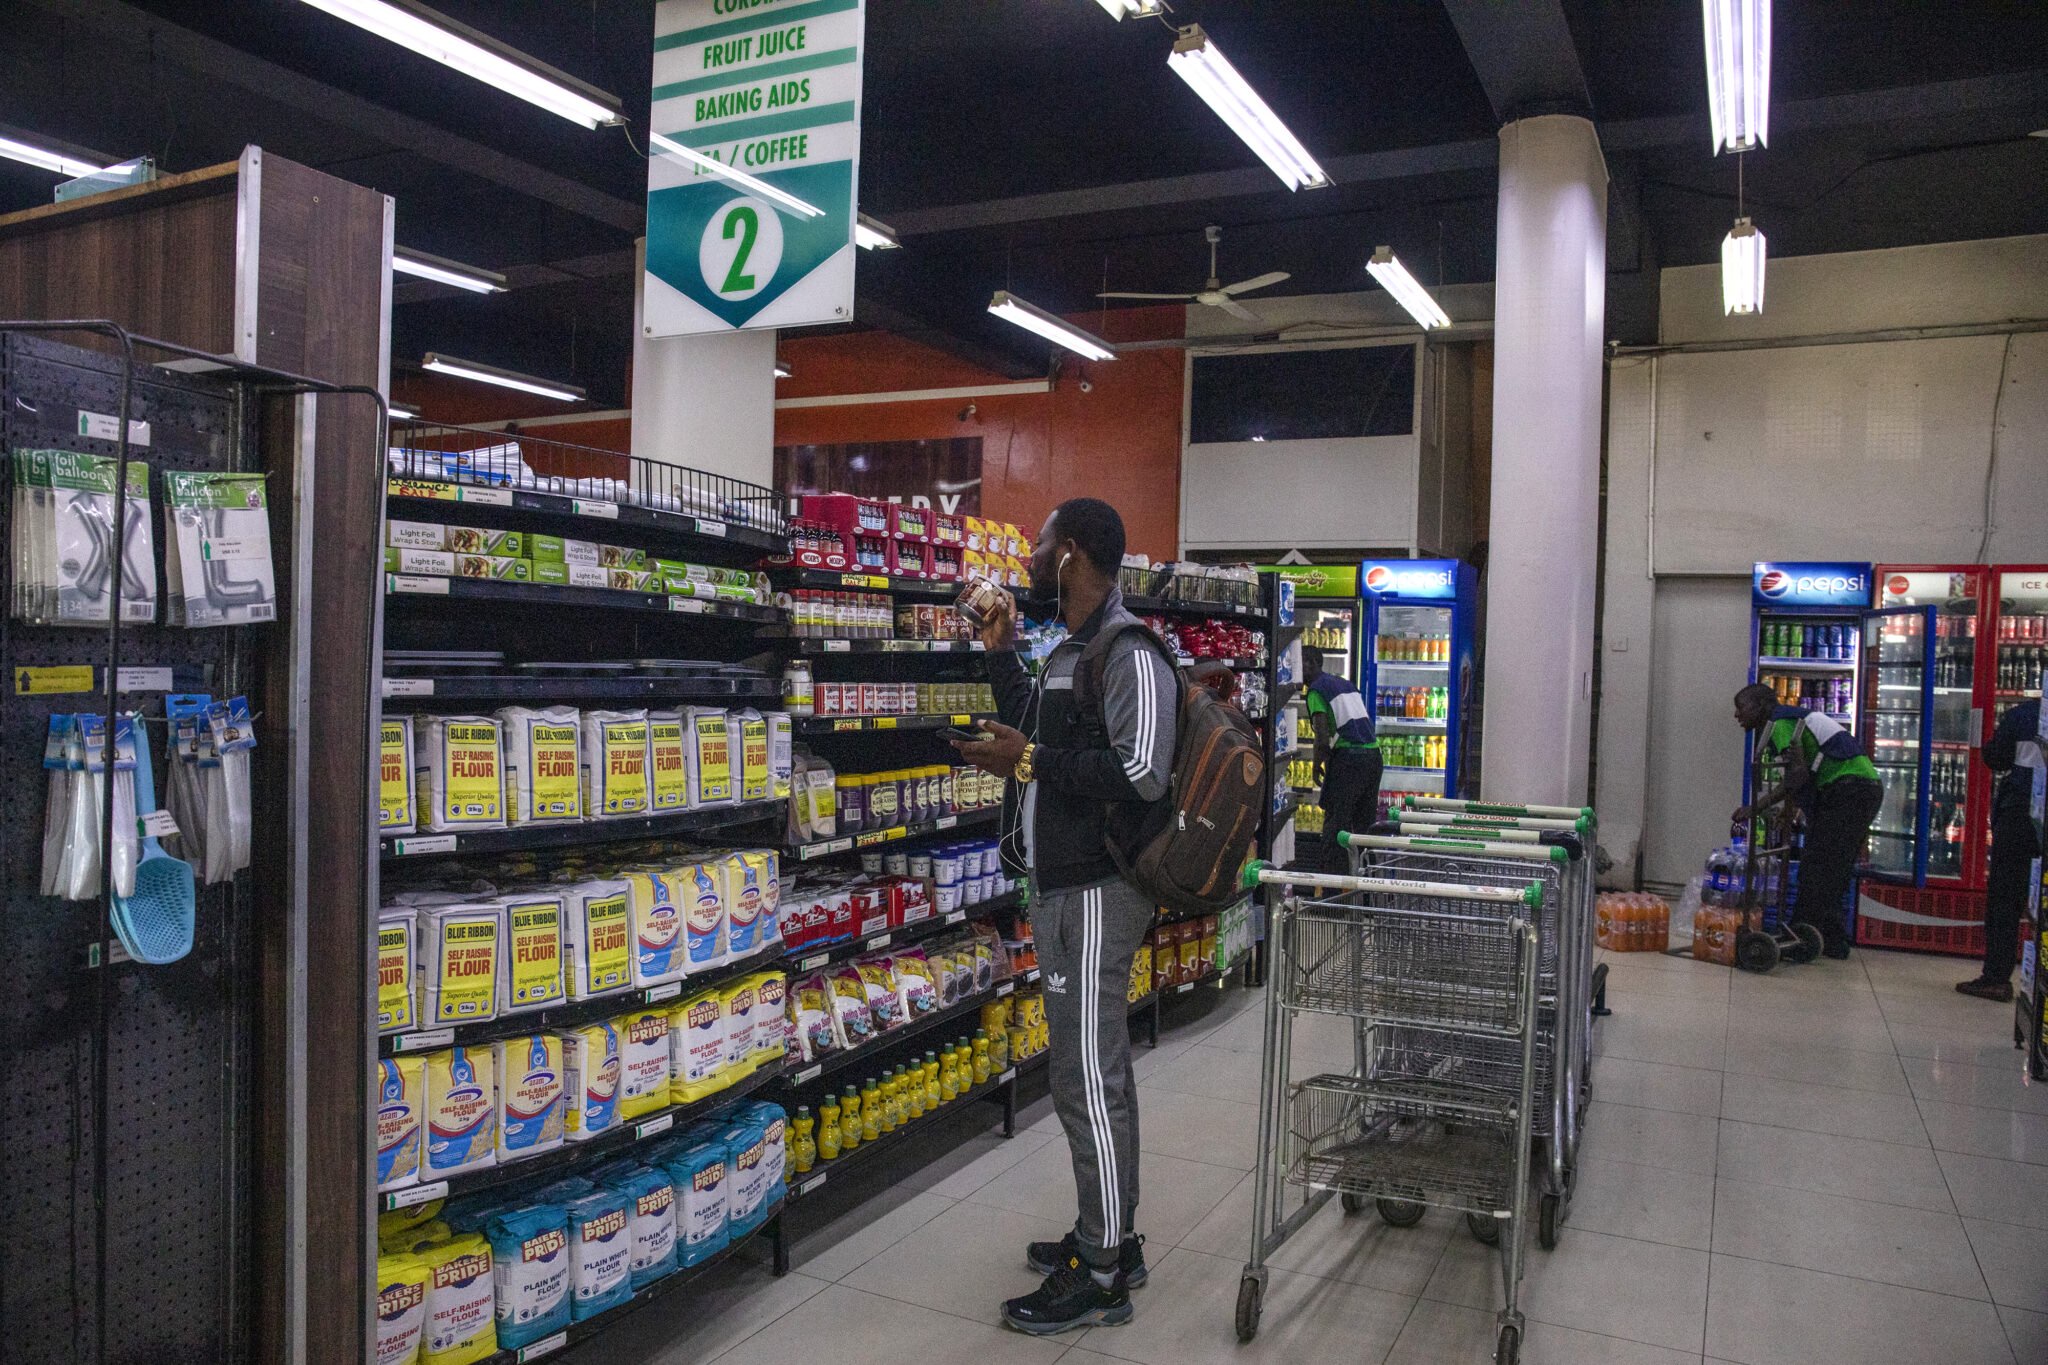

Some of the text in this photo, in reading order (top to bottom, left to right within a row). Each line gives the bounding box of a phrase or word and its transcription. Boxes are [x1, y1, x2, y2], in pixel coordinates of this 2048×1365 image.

[703, 26, 806, 69] FRUIT JUICE
[695, 78, 810, 122] BAKING AIDS
[745, 135, 807, 167] COFFEE
[720, 206, 759, 293] 2
[55, 454, 76, 466] foil
[57, 467, 106, 480] balloon
[177, 486, 221, 496] balloon
[400, 487, 437, 497] SALE
[400, 529, 419, 538] Light
[394, 536, 412, 545] Wrap
[570, 546, 582, 554] Light
[410, 557, 430, 566] Light
[405, 565, 423, 574] Wrap
[1397, 569, 1452, 588] pepsi
[1796, 573, 1865, 594] pepsi
[2022, 581, 2041, 589] ICE
[451, 728, 494, 741] BLUE RIBBON
[536, 730, 574, 740] BLUE RIBBON
[609, 730, 625, 740] BLUE
[654, 728, 667, 738] BLUE
[698, 724, 712, 734] BLUE
[745, 728, 755, 736] BLUE
[656, 747, 680, 756] SELF RAISING
[702, 742, 713, 750] SELF
[747, 745, 756, 753] SELF
[452, 751, 494, 761] SELF RAISING
[538, 751, 574, 760] SELF RAISING
[611, 751, 625, 759] SELF
[703, 752, 727, 765] FLOUR
[747, 754, 766, 766] FLOUR
[452, 762, 494, 777] FLOUR
[538, 762, 574, 776] FLOUR
[657, 757, 681, 771] FLOUR
[477, 792, 495, 801] Quality
[468, 806, 482, 814] 2kg
[1390, 880, 1426, 888] World
[591, 902, 625, 918] BLUE RIBBON
[694, 905, 721, 916] SELF-RAISING
[515, 913, 556, 927] BLUE RIBBON
[647, 918, 678, 929] SELF-RAISING
[448, 926, 493, 939] BLUE RIBBON
[593, 923, 625, 937] SELF RAISING
[657, 924, 672, 932] FLOUR
[517, 934, 556, 946] SELF RAISING
[594, 933, 625, 952] FLOUR
[448, 948, 491, 960] SELF RAISING
[517, 945, 555, 963] FLOUR
[448, 959, 490, 977] FLOUR
[1048, 985, 1066, 993] adidas
[690, 1003, 718, 1016] BAKERS
[631, 1017, 666, 1031] BAKERS
[690, 1009, 719, 1027] PRIDE
[631, 1024, 668, 1041] PRIDE
[690, 1039, 723, 1055] SELF-RAISING
[701, 1049, 717, 1058] FLOUR
[628, 1055, 668, 1071] SELF-RAISING
[641, 1065, 660, 1075] FLOUR
[517, 1083, 558, 1097] SELF-RAISING
[529, 1091, 549, 1100] FLOUR
[455, 1094, 471, 1102] azam
[440, 1099, 487, 1115] SELF-RAISING
[453, 1108, 477, 1117] FLOUR
[380, 1112, 398, 1120] azam
[739, 1147, 764, 1170] PRIDE
[695, 1162, 724, 1179] BAKERS
[695, 1171, 724, 1191] PRIDE
[639, 1185, 672, 1204] BAKERS
[738, 1183, 753, 1194] PLAIN
[639, 1192, 673, 1215] PRIDE
[694, 1198, 725, 1217] PLAIN WHITE
[585, 1209, 624, 1229] BAKERS
[704, 1210, 719, 1220] FLOUR
[585, 1219, 625, 1241] PRIDE
[639, 1232, 660, 1243] PLAIN
[651, 1233, 668, 1246] FLOUR
[524, 1235, 565, 1261] PRIDE
[436, 1254, 488, 1273] BAKERS
[584, 1249, 628, 1271] PLAIN WHITE
[437, 1260, 488, 1287] PRIDE
[598, 1262, 620, 1274] FLOUR
[524, 1268, 567, 1293] PLAIN WHITE
[537, 1281, 560, 1296] FLOUR
[434, 1295, 491, 1320] SELF-RAISING
[452, 1309, 480, 1324] FLOUR
[461, 1340, 473, 1348] 2kg
